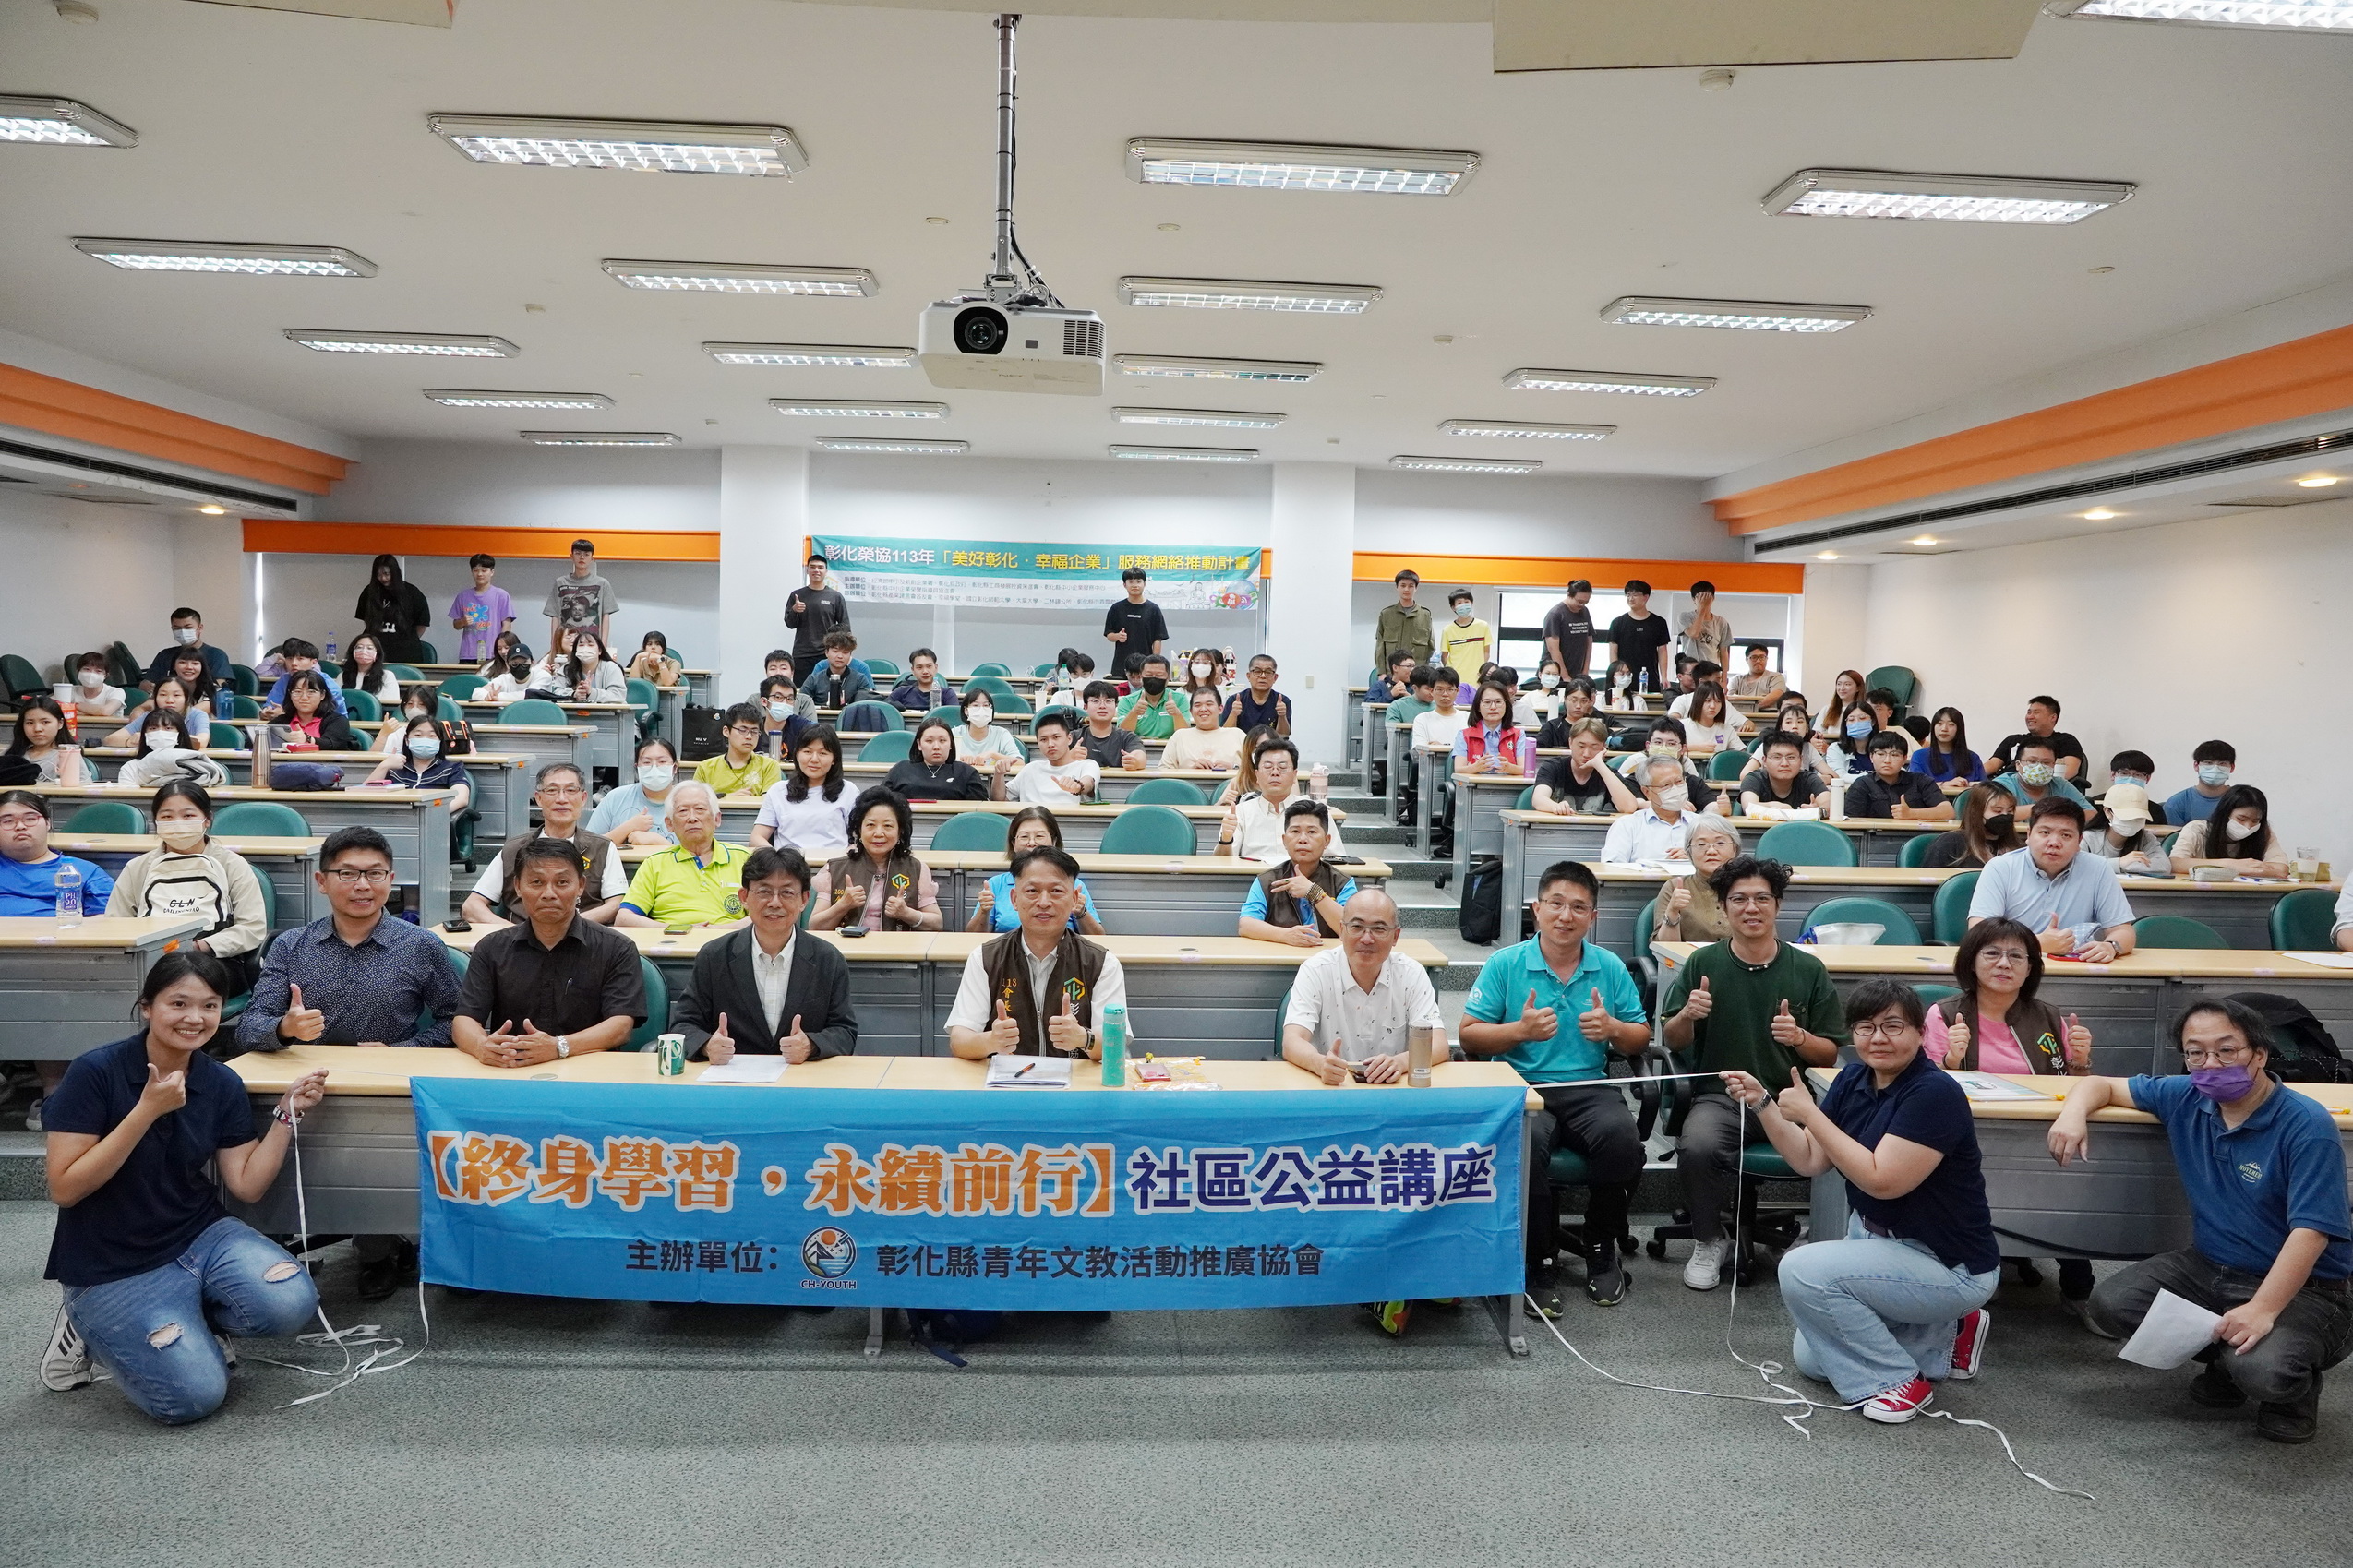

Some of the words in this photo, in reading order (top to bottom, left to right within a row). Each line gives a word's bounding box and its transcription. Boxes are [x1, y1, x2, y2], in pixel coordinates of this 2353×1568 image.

[877, 1243, 1325, 1279] 彰化縣青年文教活動推廣協會
[800, 1279, 858, 1290] CH-YOUTH
